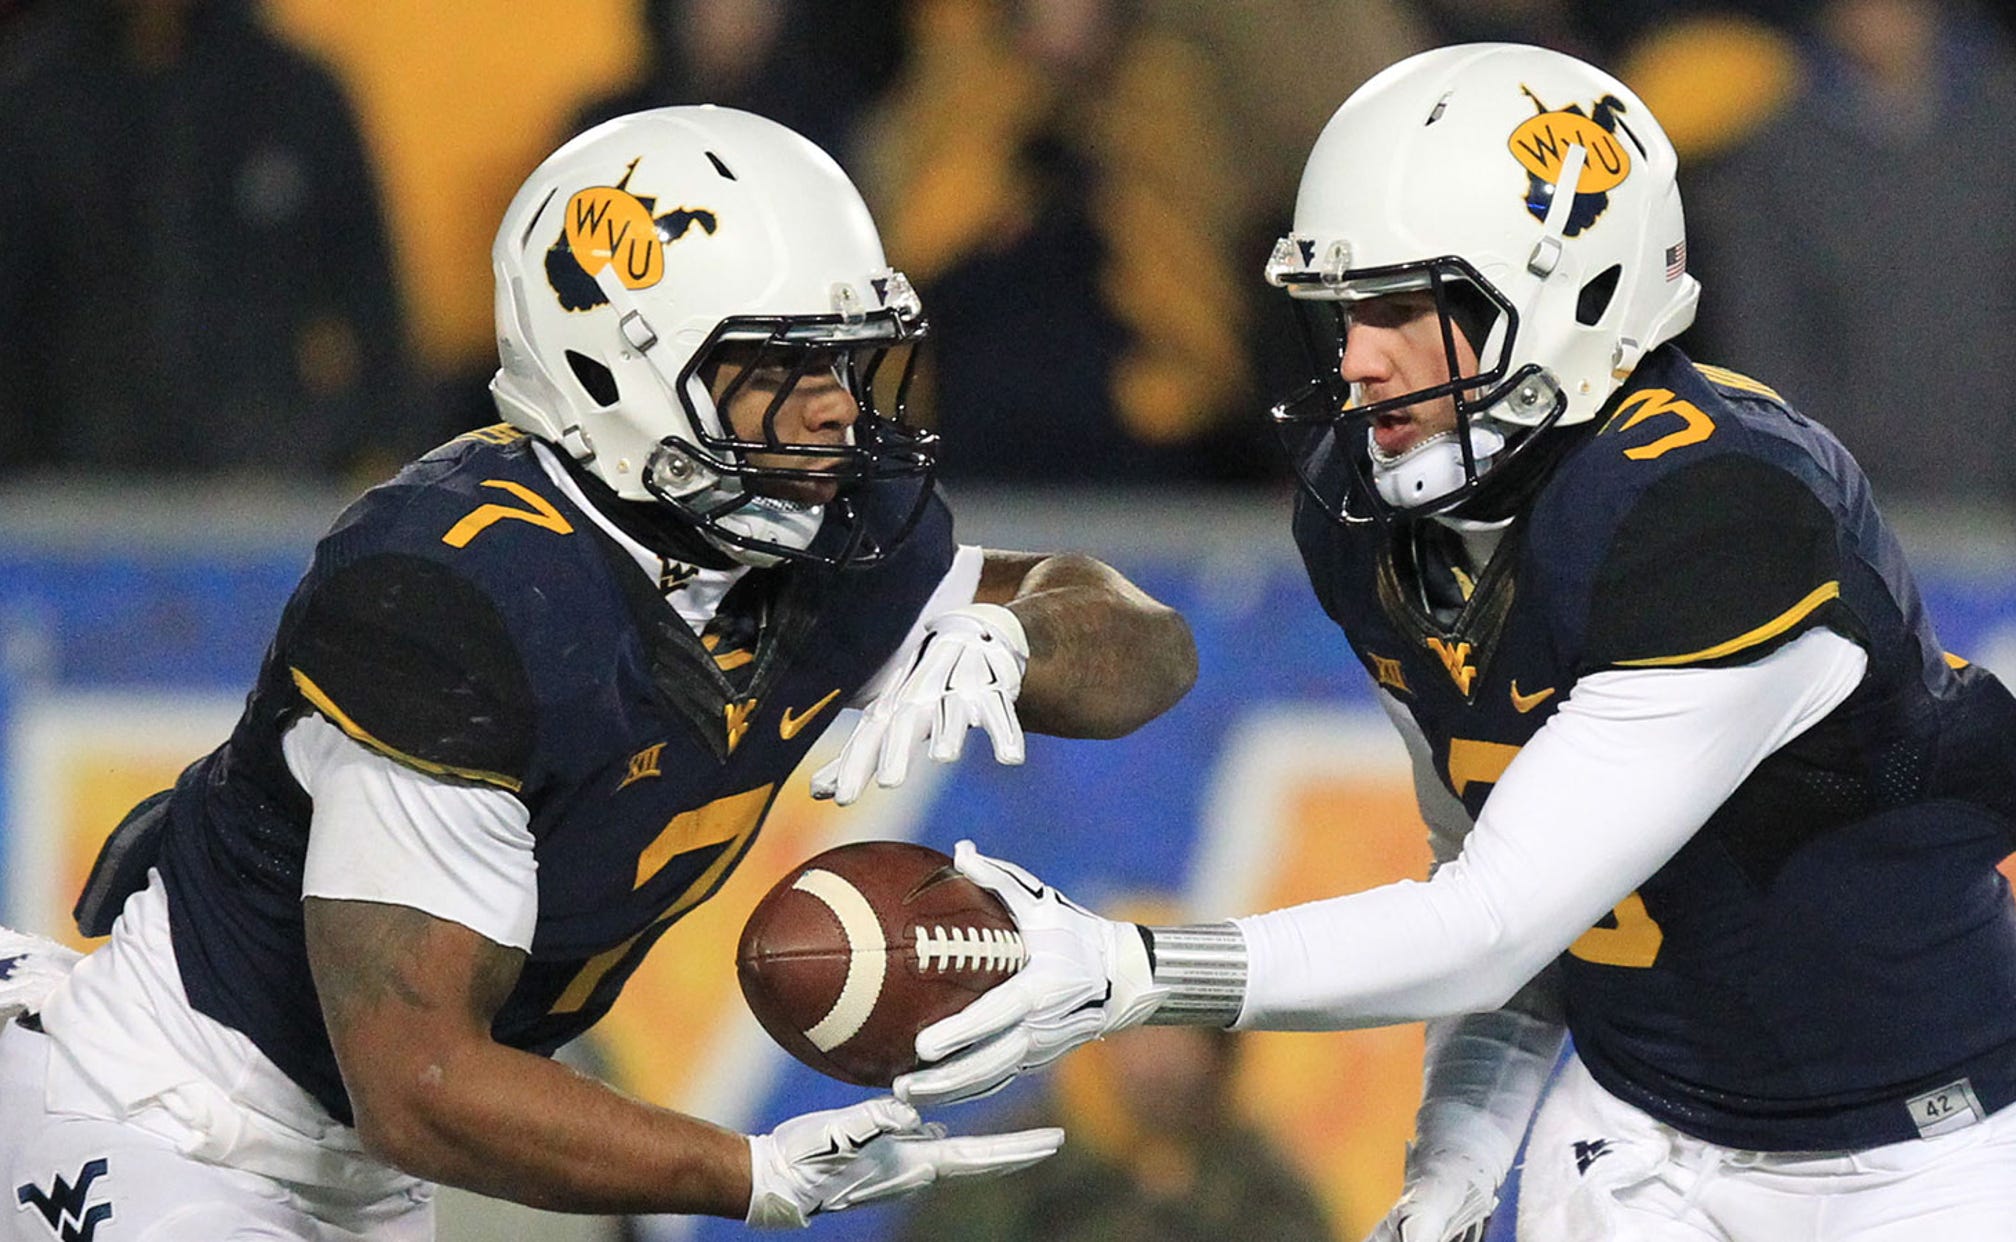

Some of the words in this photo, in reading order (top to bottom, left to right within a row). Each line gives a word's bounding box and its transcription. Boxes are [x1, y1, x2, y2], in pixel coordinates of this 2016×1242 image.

[575, 197, 654, 281] WVU
[1599, 387, 1717, 461] 3
[440, 478, 575, 549] 7
[546, 781, 776, 1016] 7
[1926, 1094, 1954, 1117] 42
